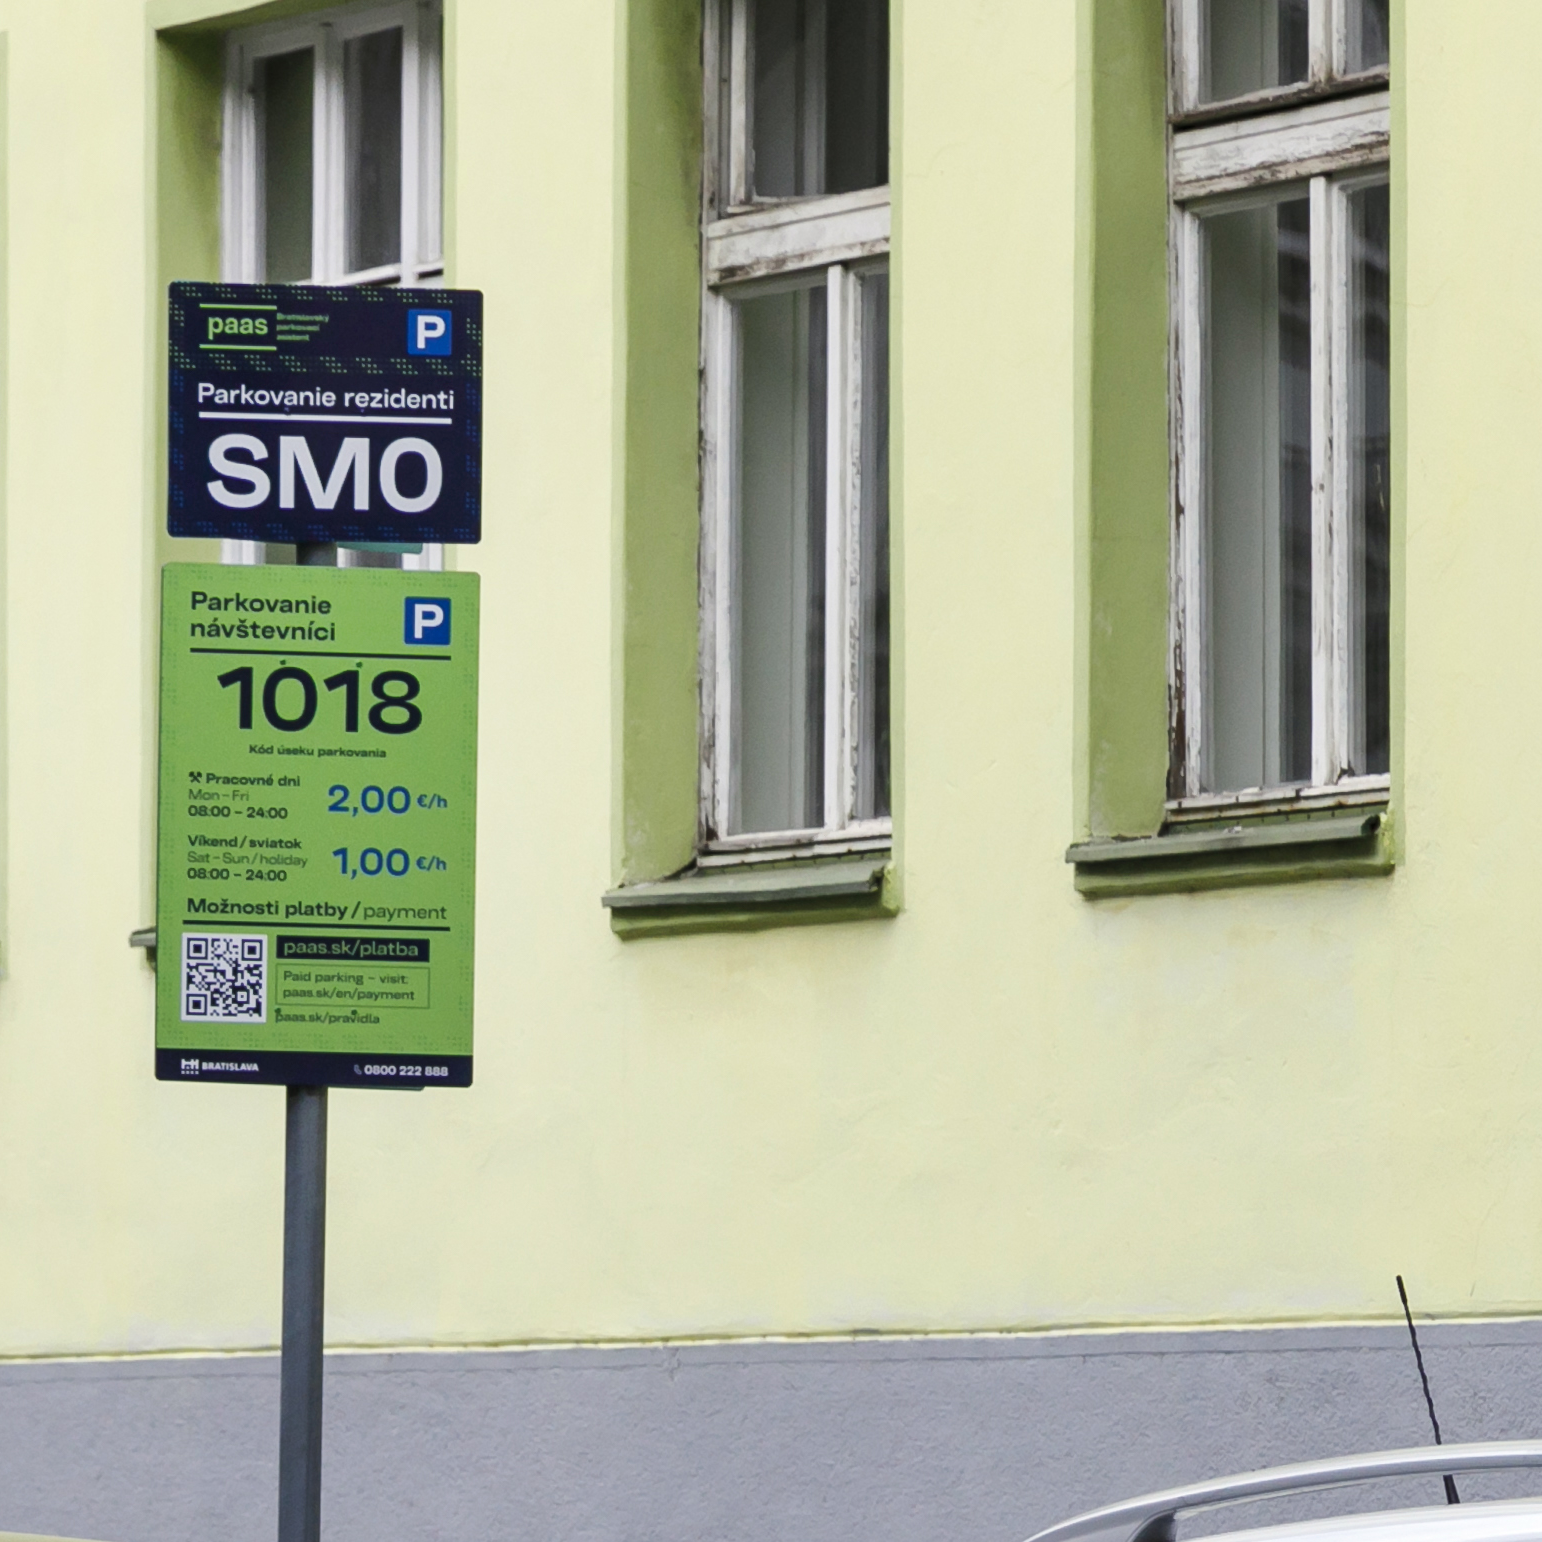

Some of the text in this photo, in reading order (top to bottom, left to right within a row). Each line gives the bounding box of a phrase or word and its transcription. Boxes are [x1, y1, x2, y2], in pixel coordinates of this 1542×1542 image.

[208, 316, 268, 340] paas
[416, 315, 446, 349] P
[197, 382, 455, 409] Parkovanie rezidenti
[206, 433, 443, 513] SMO
[191, 591, 332, 614] Parkovanie
[190, 617, 336, 641] návštevníci
[414, 603, 444, 639] P
[217, 666, 423, 735] 1018
[249, 744, 387, 758] Kód úseku parkovania
[206, 773, 301, 787] Pracovné dni
[327, 784, 448, 817] 2,00 €/h
[188, 805, 231, 818] 08:00
[246, 806, 288, 819] 24:00
[332, 847, 447, 880] 1,00 €/h
[187, 867, 230, 880] 08:00
[245, 869, 287, 882] 24:00
[187, 897, 279, 916] Možnosti
[284, 939, 419, 958] paas.sk/platba
[283, 970, 311, 982] Paid
[314, 972, 364, 985] parking
[283, 987, 415, 1001] paas.sk/en/payment
[275, 1011, 380, 1025] paas.sk/pravidla
[202, 1061, 259, 1072] BRATISLAVA
[364, 1064, 448, 1077] 0800 222 888
